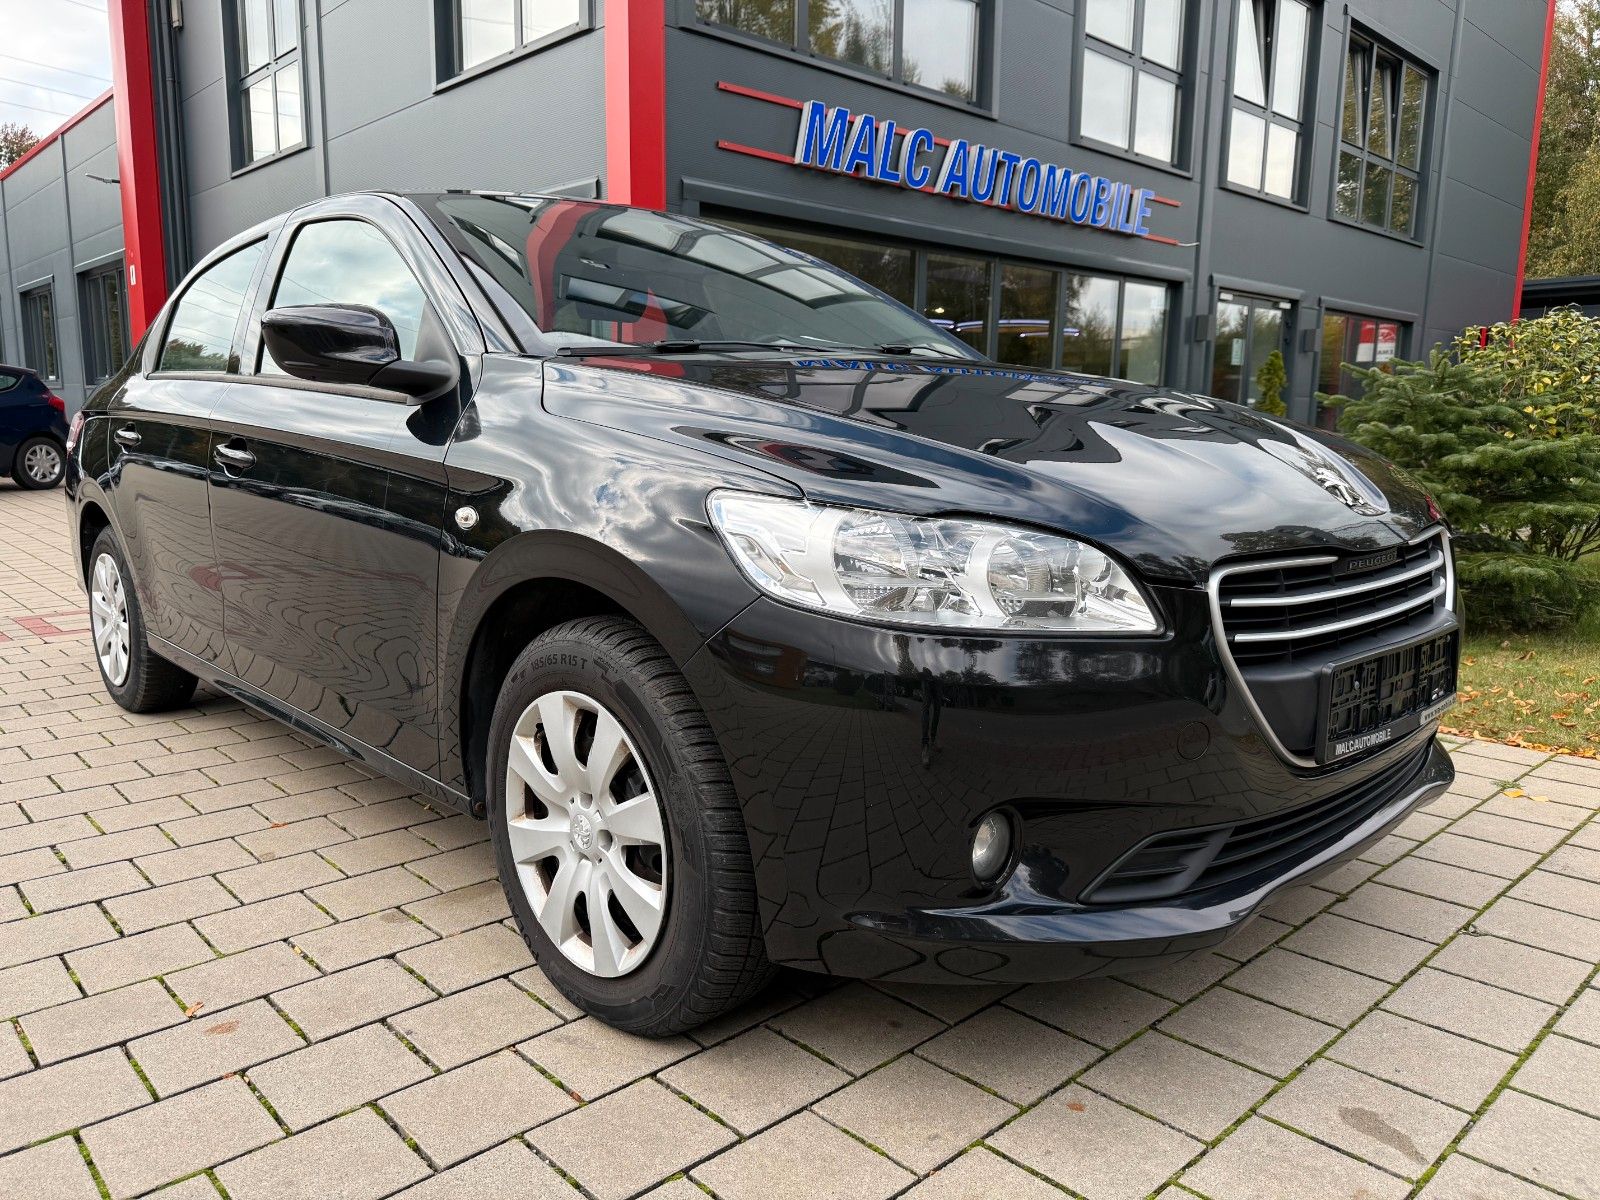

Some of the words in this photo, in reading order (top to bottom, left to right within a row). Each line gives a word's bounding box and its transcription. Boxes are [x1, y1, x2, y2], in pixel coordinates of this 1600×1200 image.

[799, 100, 935, 189] MALC
[940, 139, 1156, 236] AUTOMOBILE
[1349, 549, 1398, 570] PEUGEOT
[530, 653, 558, 672] 185/65
[560, 653, 578, 667] R15
[580, 657, 588, 670] T
